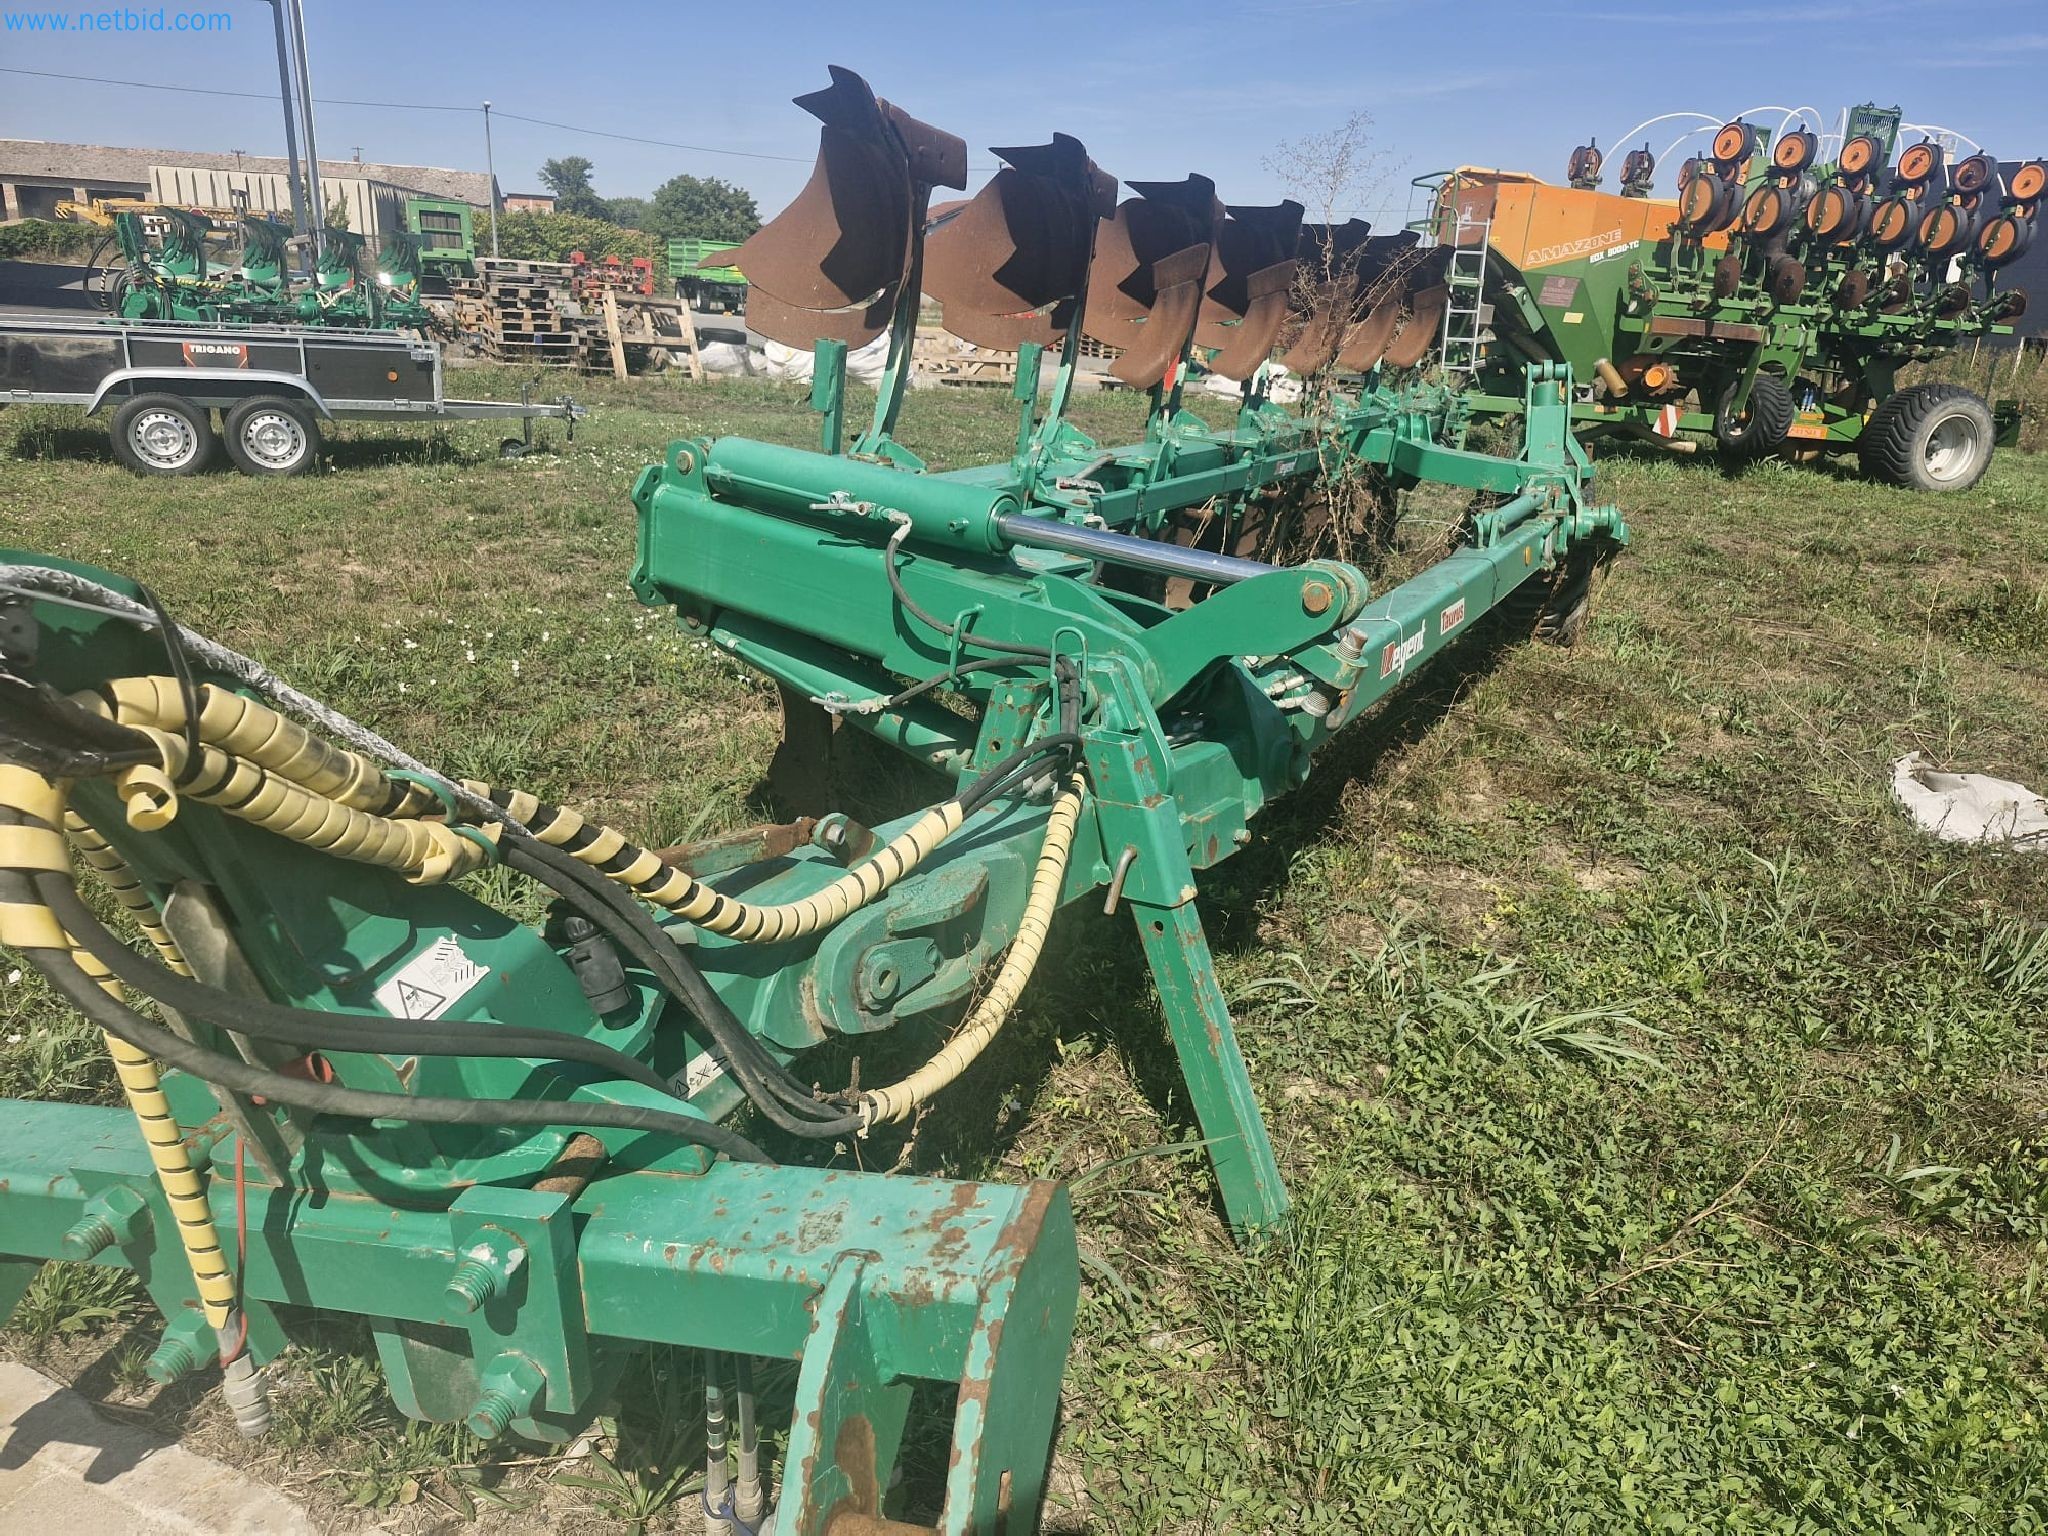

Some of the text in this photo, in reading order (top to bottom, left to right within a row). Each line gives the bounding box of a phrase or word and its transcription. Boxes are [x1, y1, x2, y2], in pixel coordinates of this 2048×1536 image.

[1527, 229, 1621, 264] AMAZONE
[189, 345, 241, 355] TRIGANO
[1441, 604, 1464, 632] Taurus
